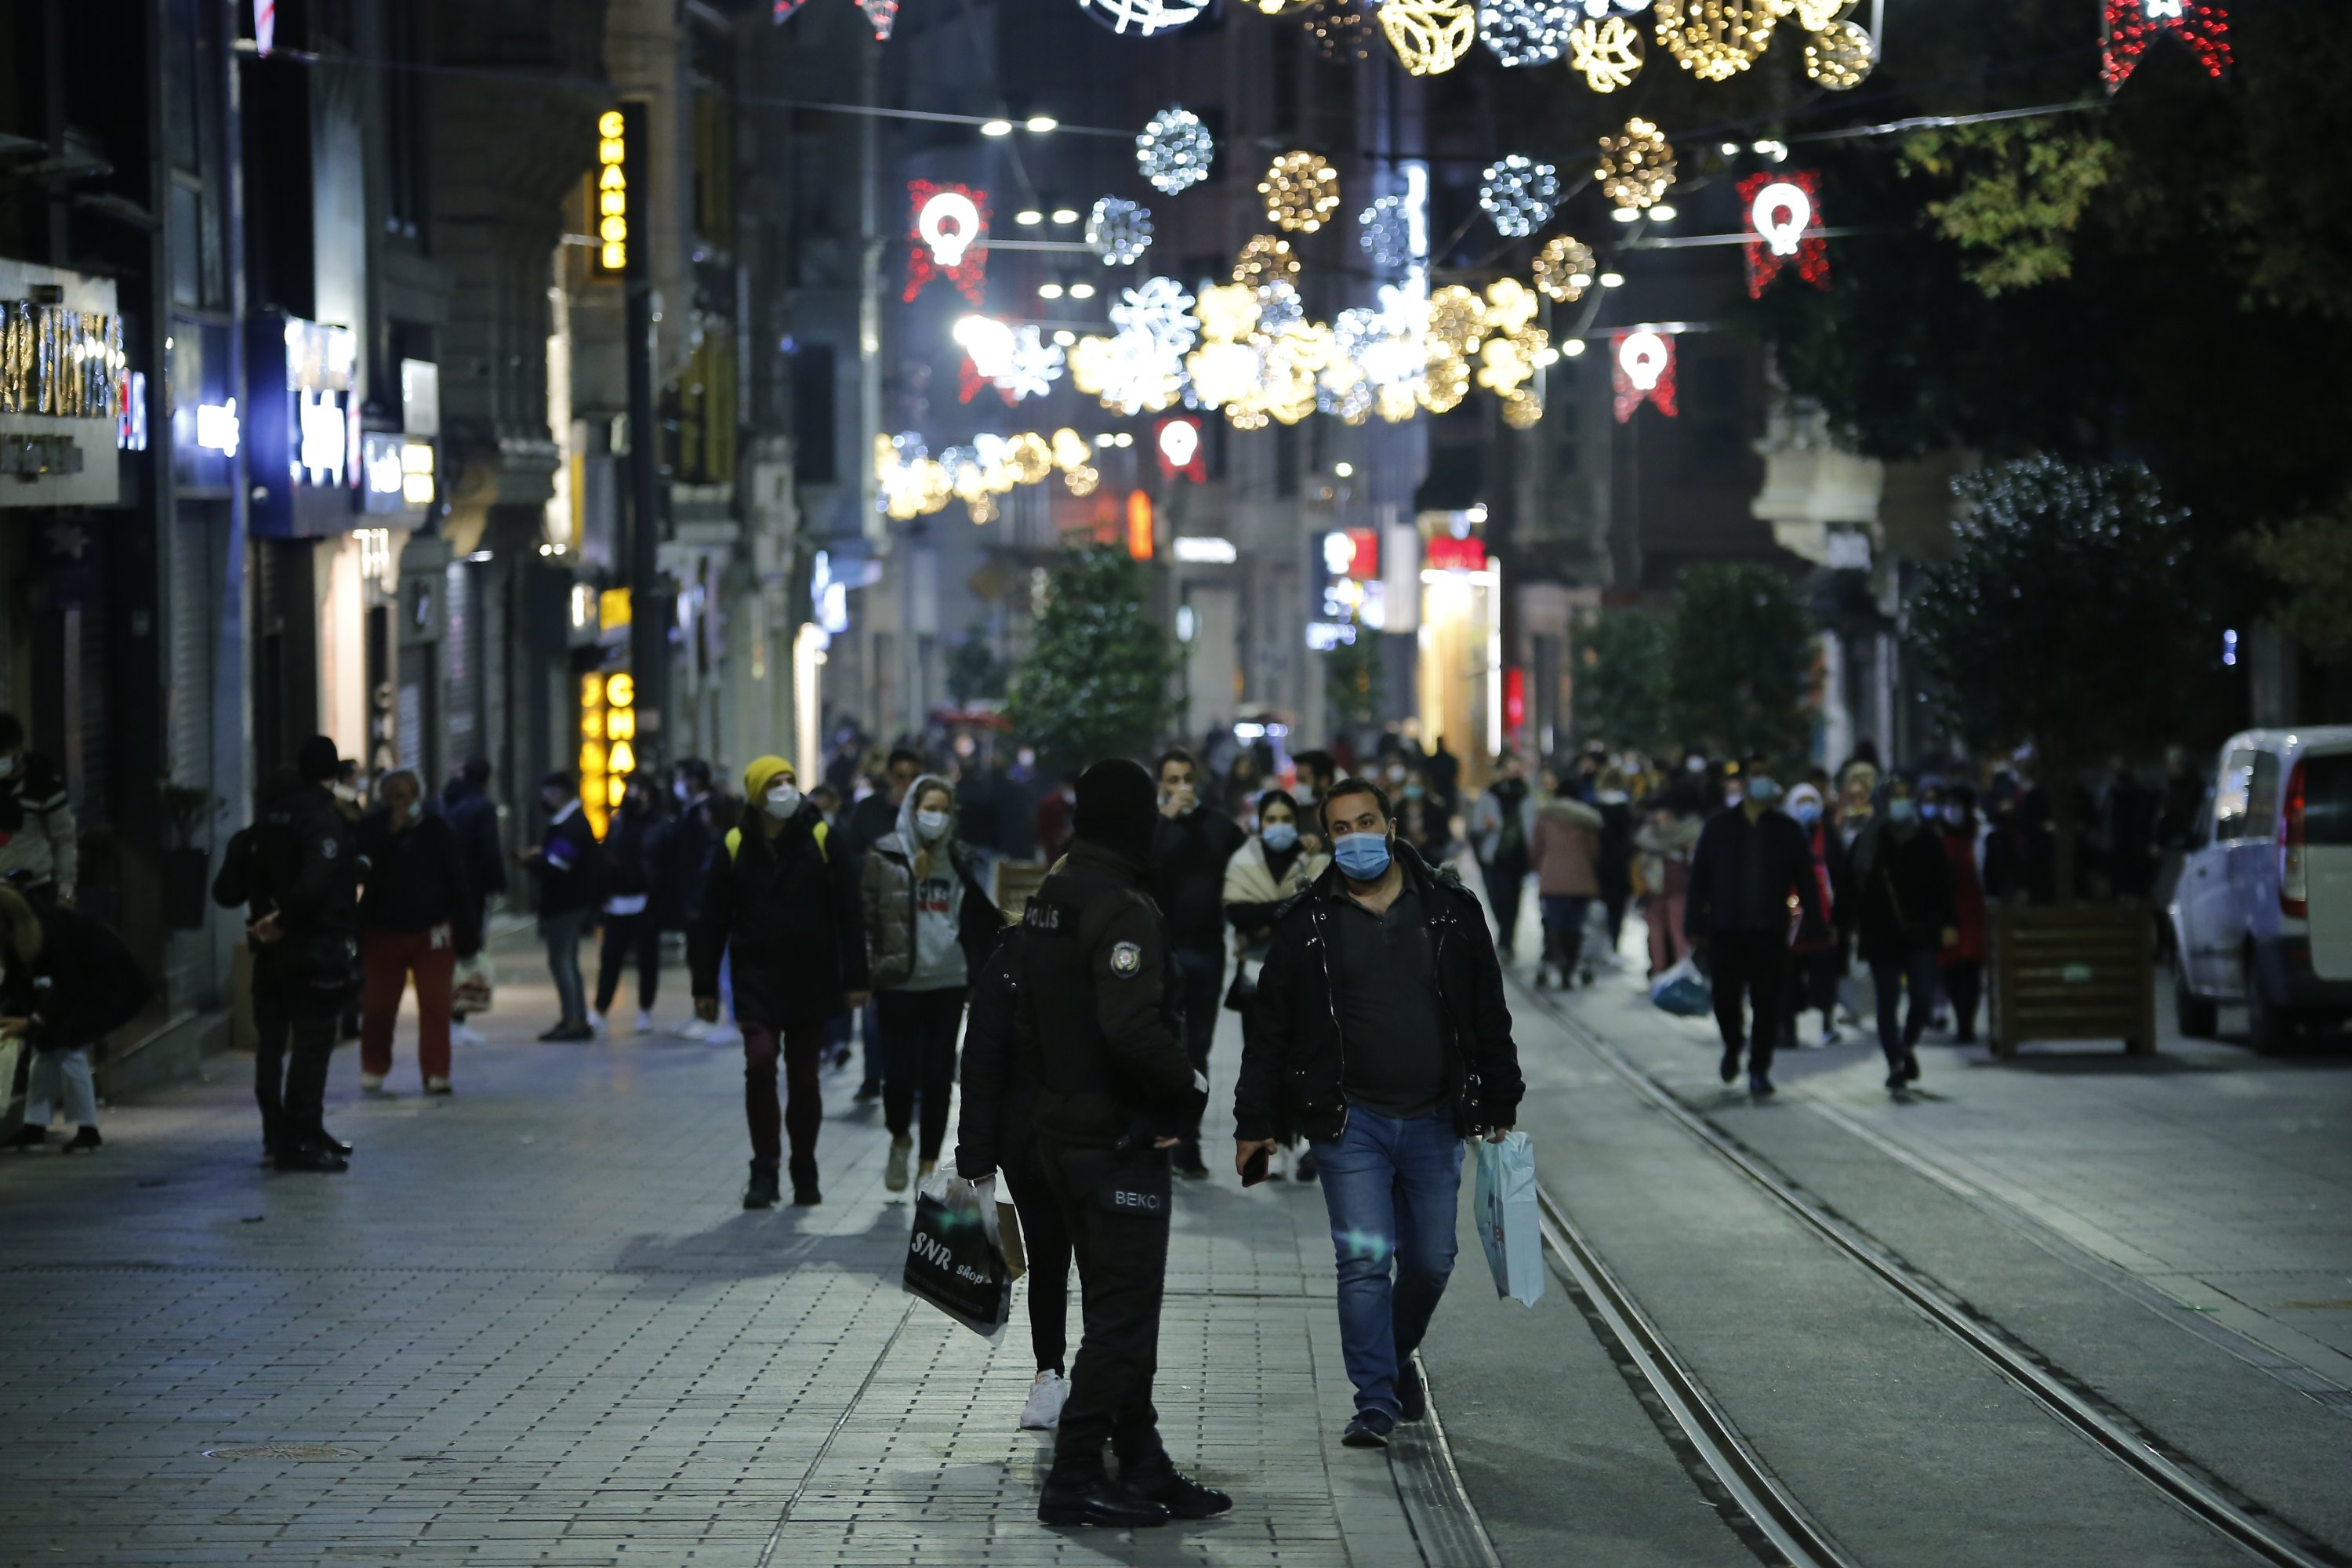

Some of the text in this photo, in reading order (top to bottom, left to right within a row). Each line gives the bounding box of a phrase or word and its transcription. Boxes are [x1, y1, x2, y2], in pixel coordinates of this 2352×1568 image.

[599, 111, 627, 269] CHANGE
[911, 1232, 953, 1272] SNR
[956, 1265, 985, 1286] shop
